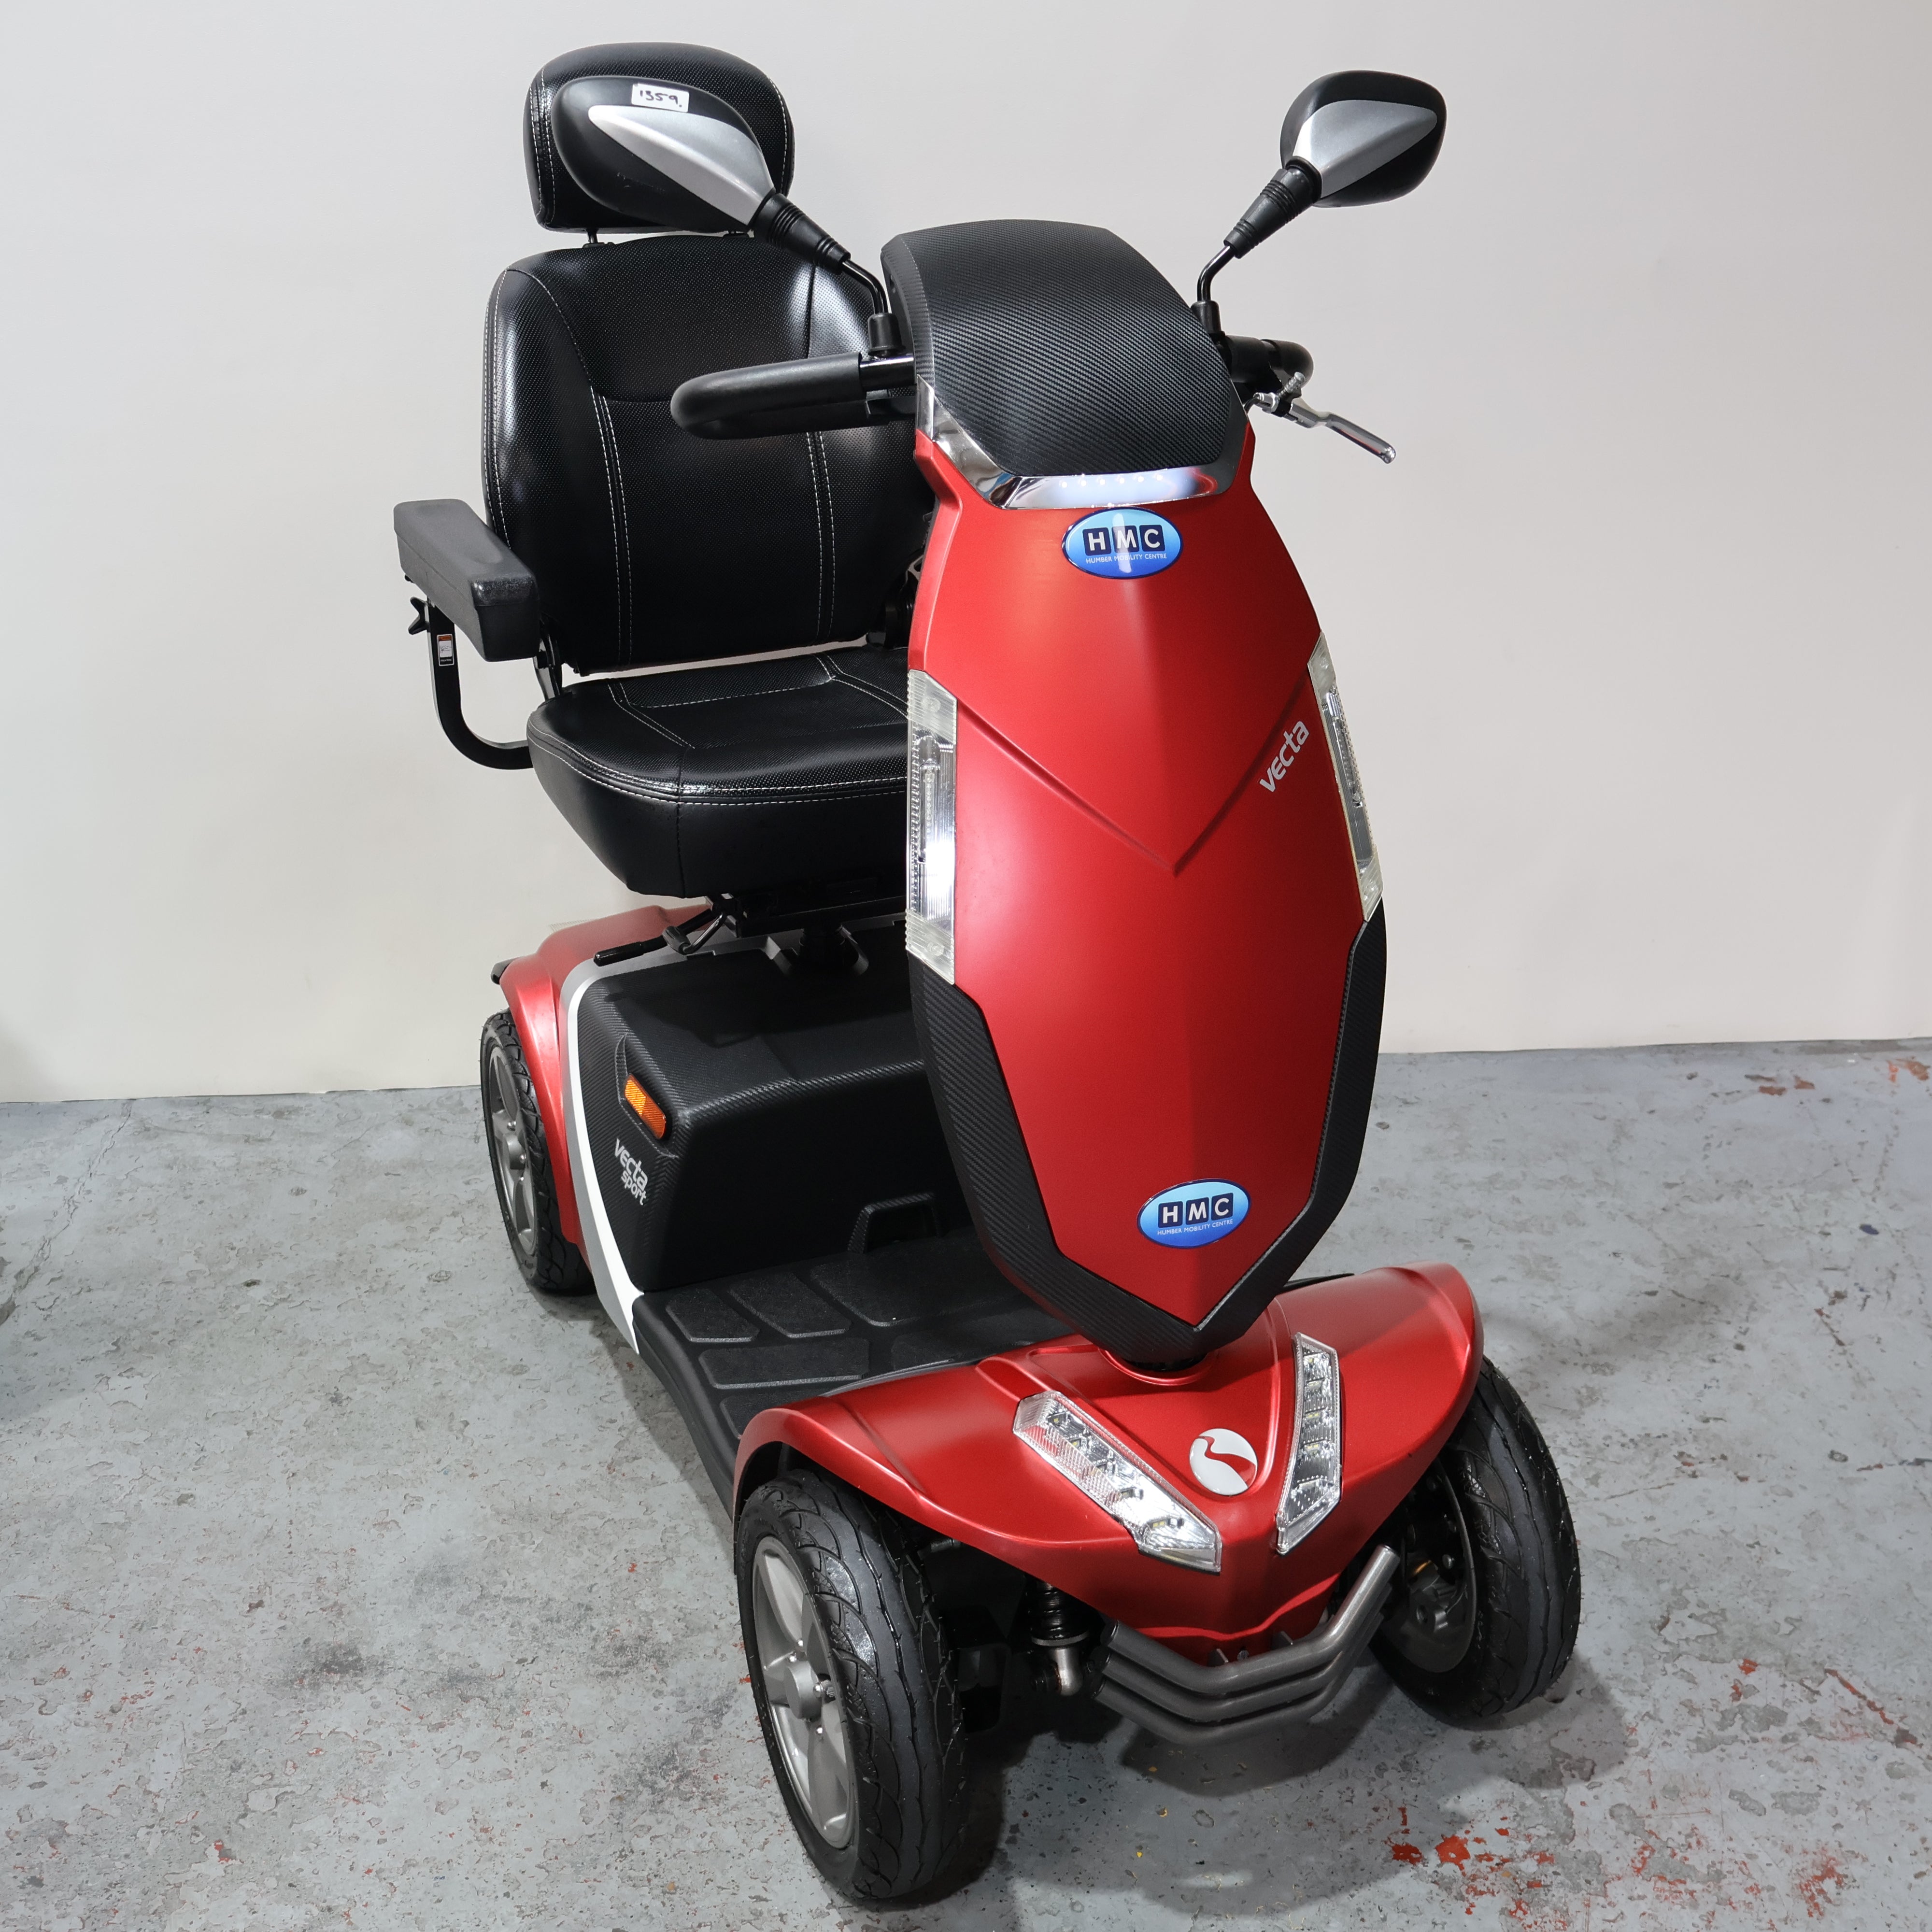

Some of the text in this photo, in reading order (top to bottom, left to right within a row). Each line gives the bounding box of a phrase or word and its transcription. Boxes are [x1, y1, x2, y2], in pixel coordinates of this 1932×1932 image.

[1088, 528, 1161, 551] HMC
[1086, 556, 1112, 564] HUMBER
[621, 1170, 647, 1206] sport
[1163, 1197, 1230, 1223] HMC
[1184, 1223, 1211, 1233] MOBILITY
[1212, 1219, 1234, 1228] CENTRE
